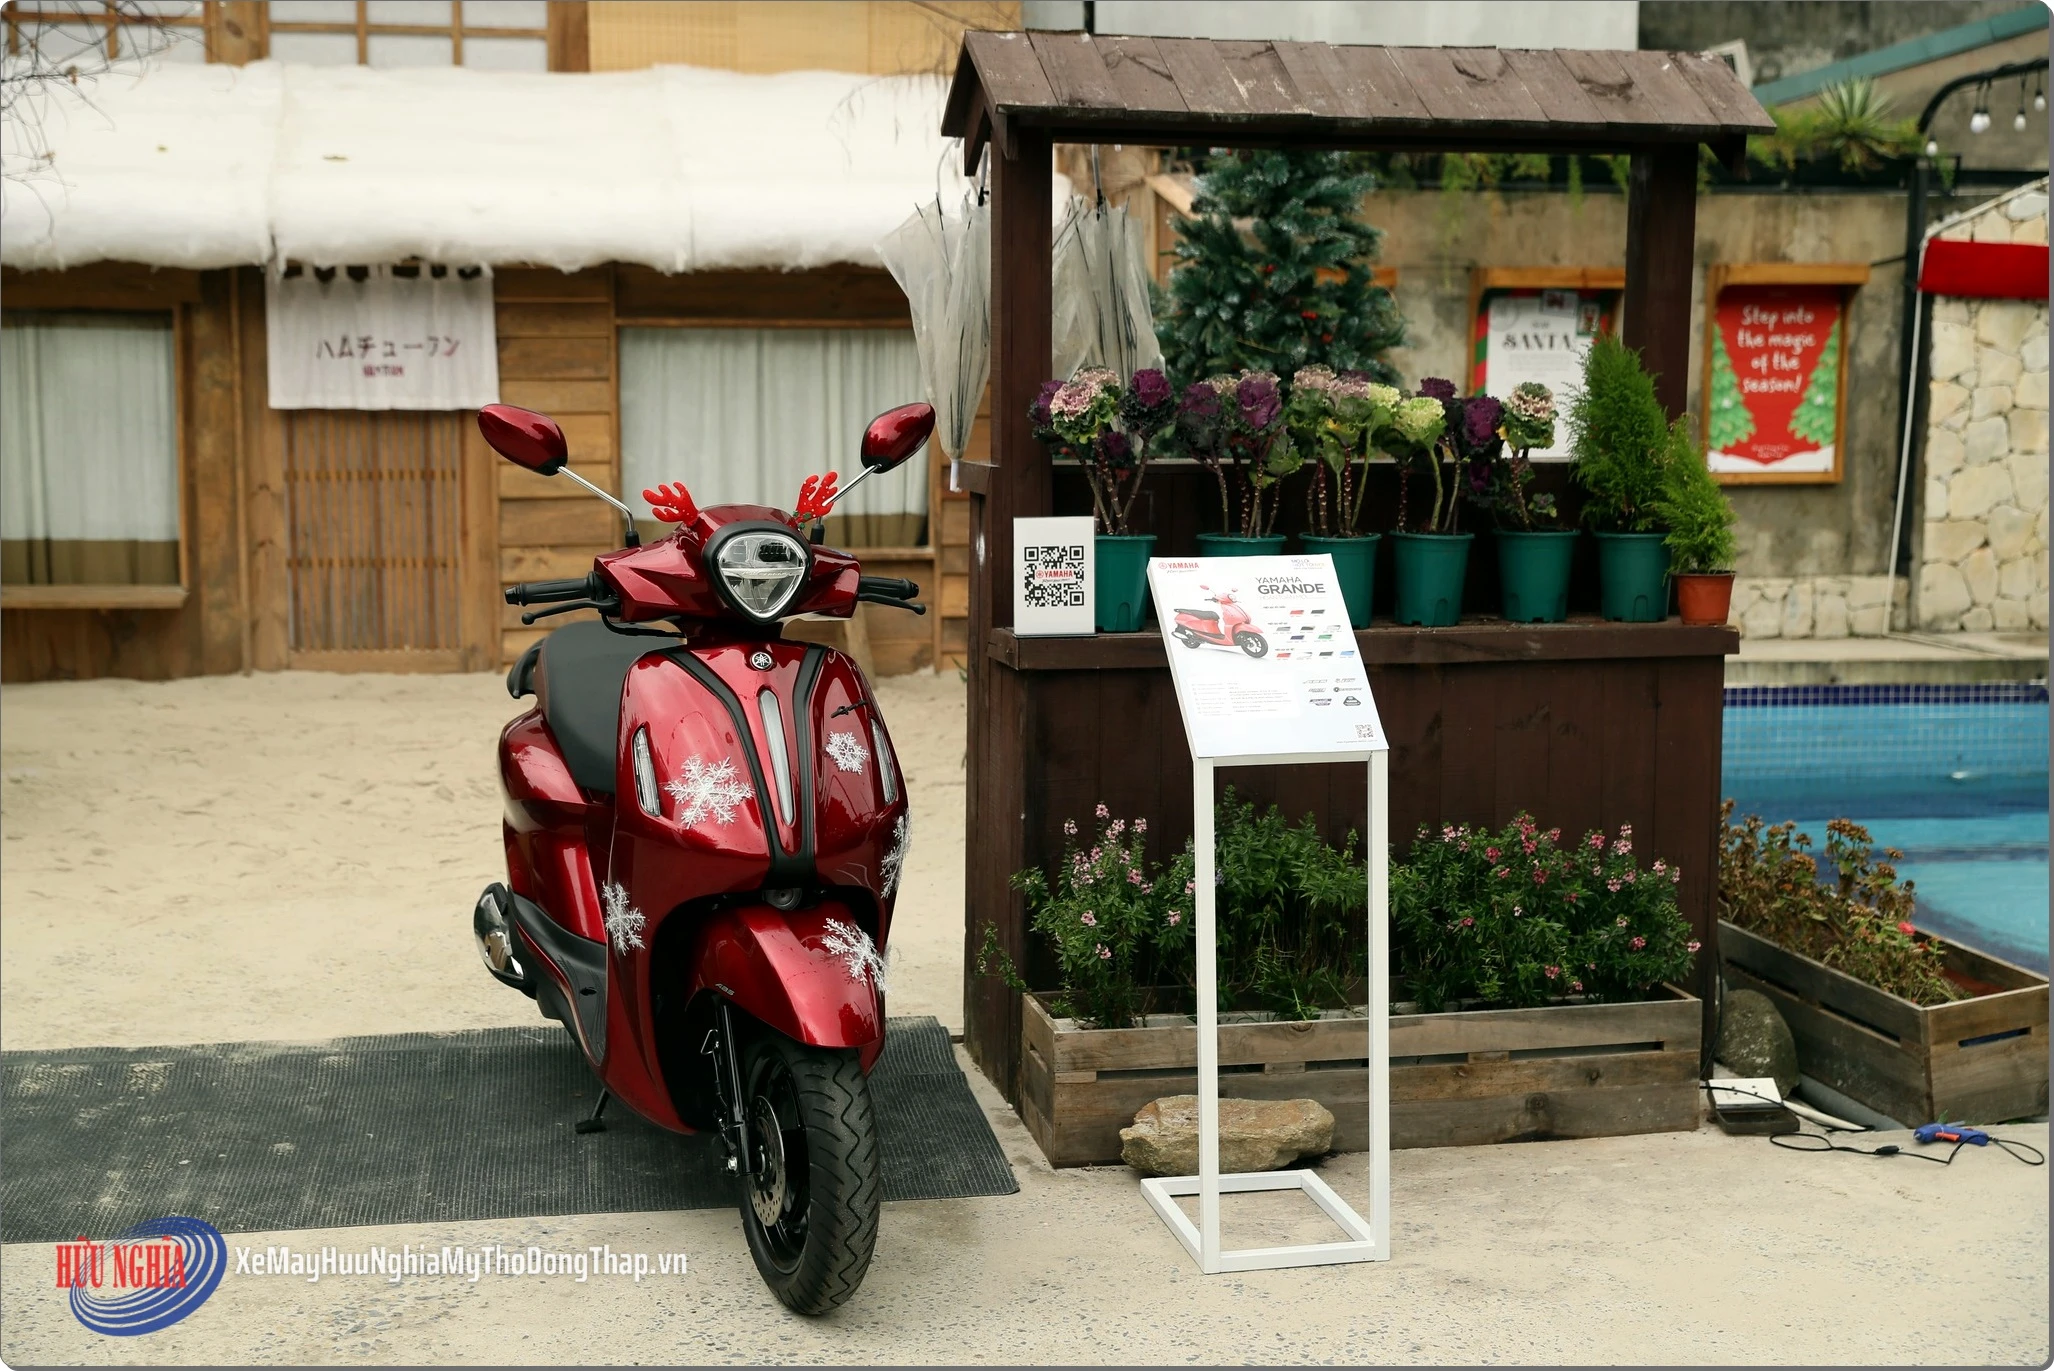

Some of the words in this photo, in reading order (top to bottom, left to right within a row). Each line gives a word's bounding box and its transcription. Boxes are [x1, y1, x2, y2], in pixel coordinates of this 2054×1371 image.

[1741, 305, 1778, 331] Step
[1782, 306, 1815, 325] into
[1503, 333, 1571, 351] SANTA
[1737, 328, 1765, 348] the
[1768, 333, 1816, 355] magic
[1751, 353, 1768, 375] of
[1772, 350, 1800, 371] the
[1743, 374, 1802, 393] season!
[1044, 570, 1073, 578] YAMAHA
[1255, 576, 1302, 584] YAMAHA
[1257, 583, 1326, 595] GRANDE
